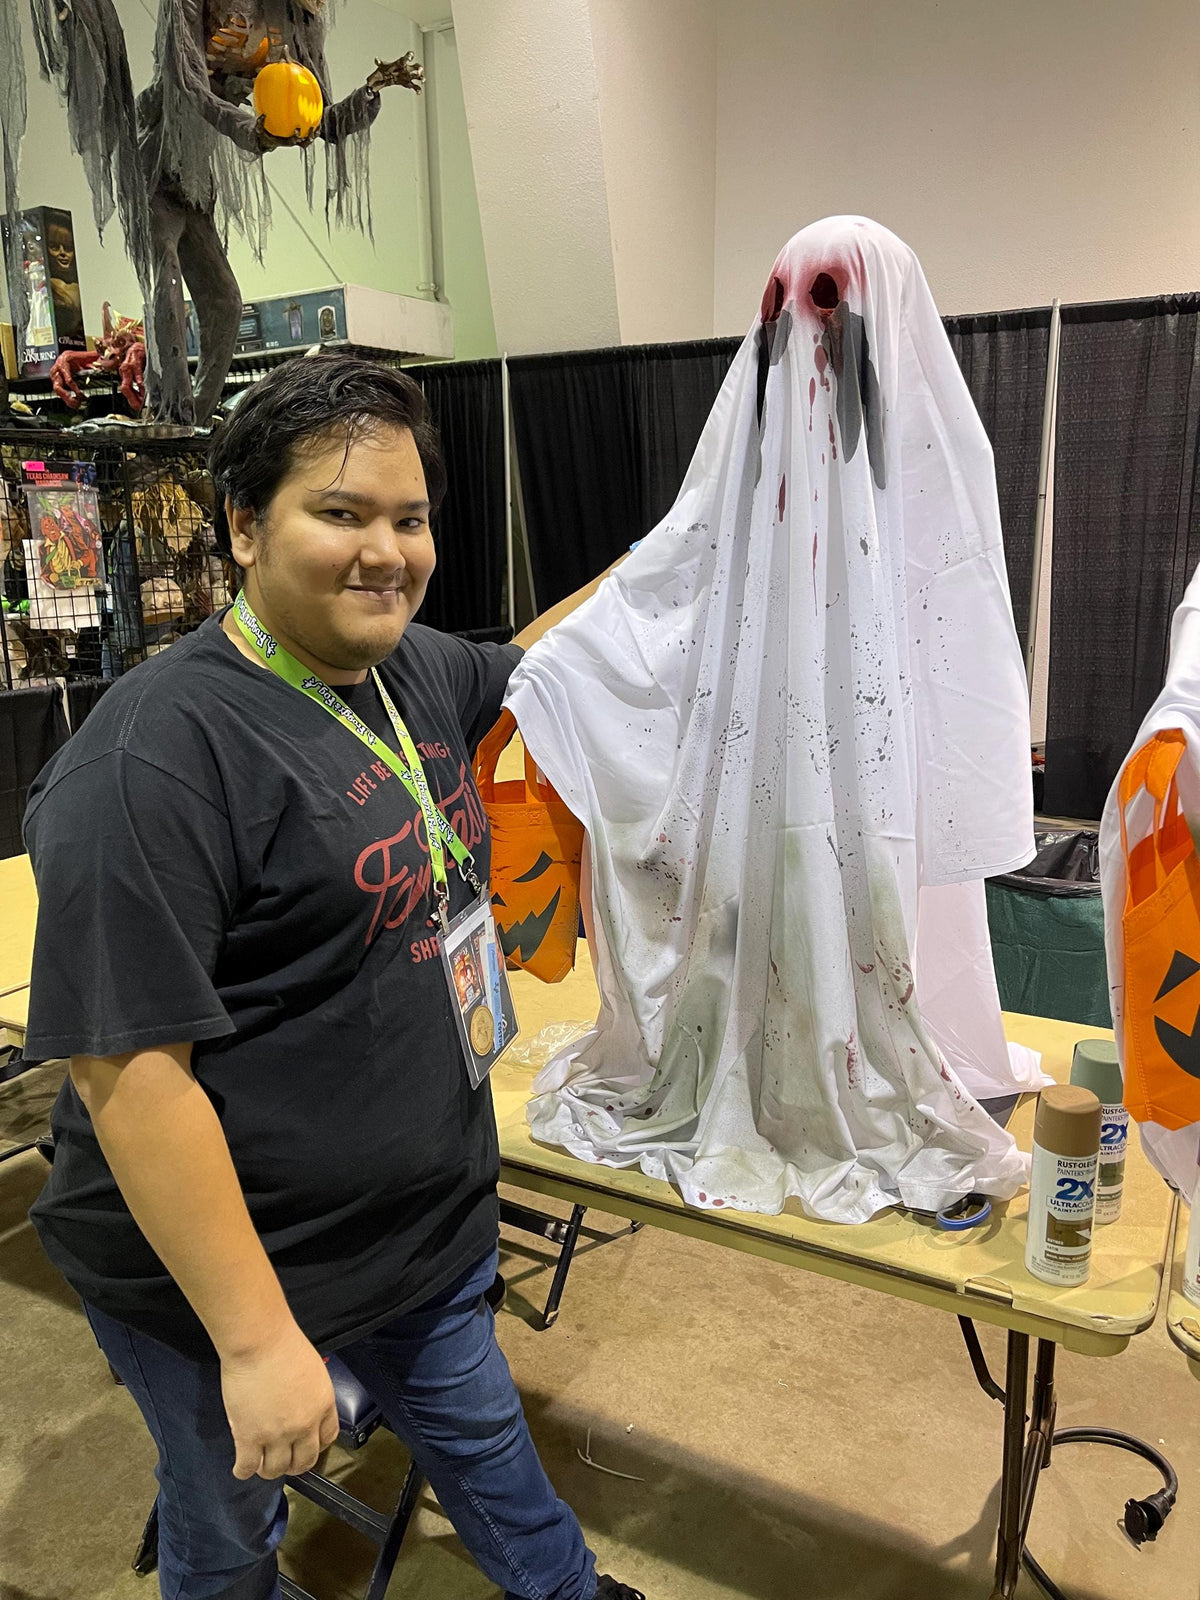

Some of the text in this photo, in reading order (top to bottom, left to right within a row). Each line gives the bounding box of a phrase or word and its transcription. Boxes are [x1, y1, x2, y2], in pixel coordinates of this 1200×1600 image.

[318, 683, 335, 708] Fog
[346, 771, 378, 806] LIFE
[1101, 1123, 1129, 1144] 2X
[1055, 1177, 1095, 1201] 2X
